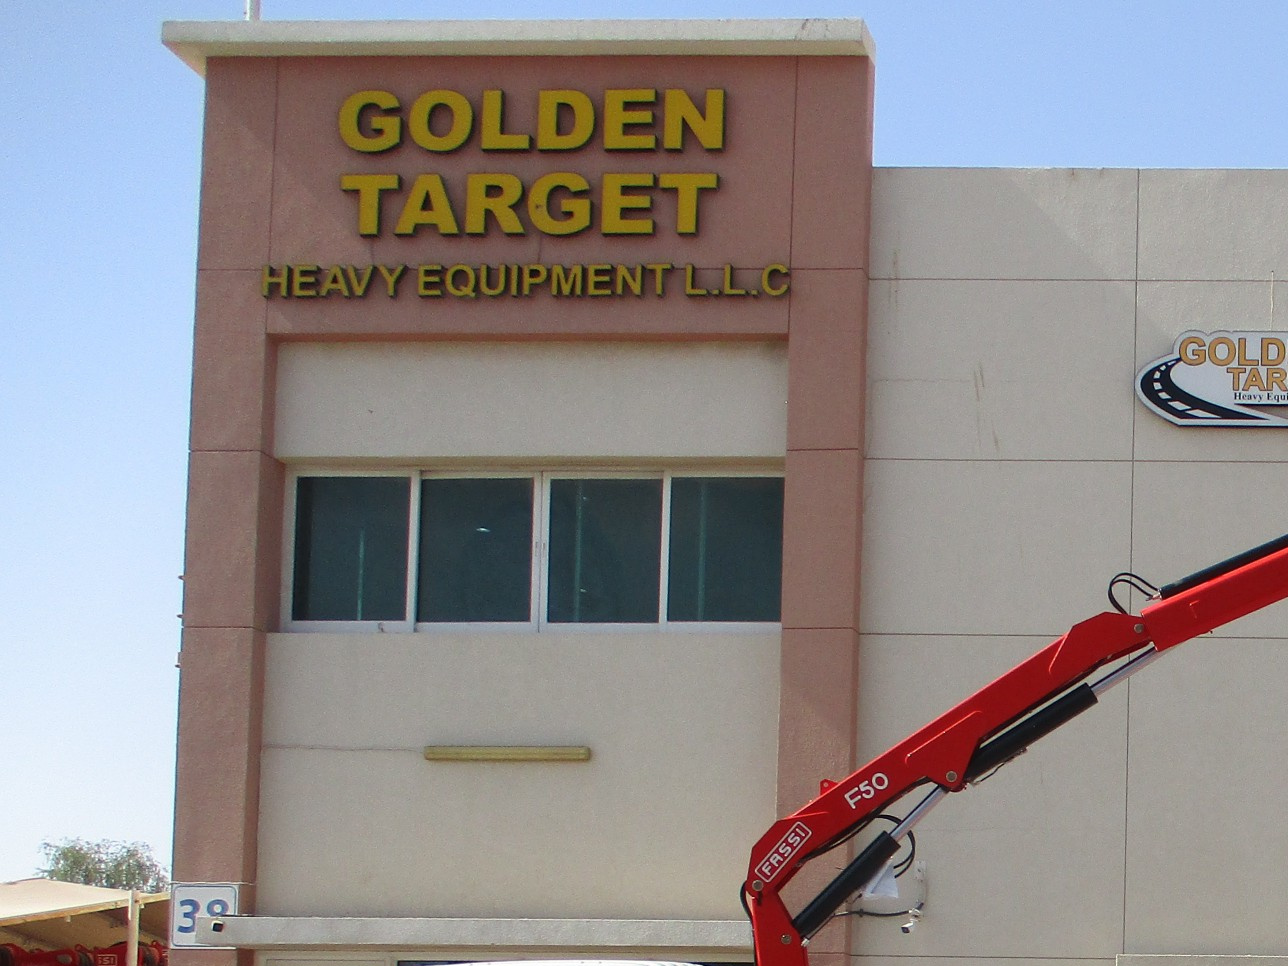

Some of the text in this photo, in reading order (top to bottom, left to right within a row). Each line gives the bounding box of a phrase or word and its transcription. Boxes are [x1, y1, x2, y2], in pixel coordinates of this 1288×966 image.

[338, 89, 726, 154] GOLDEN
[341, 172, 719, 237] TARGET
[260, 264, 790, 300] HEAVY EQUIPMENT L.L.C
[1233, 392, 1263, 402] Heavy
[844, 772, 889, 810] F50
[761, 827, 806, 876] FASSI
